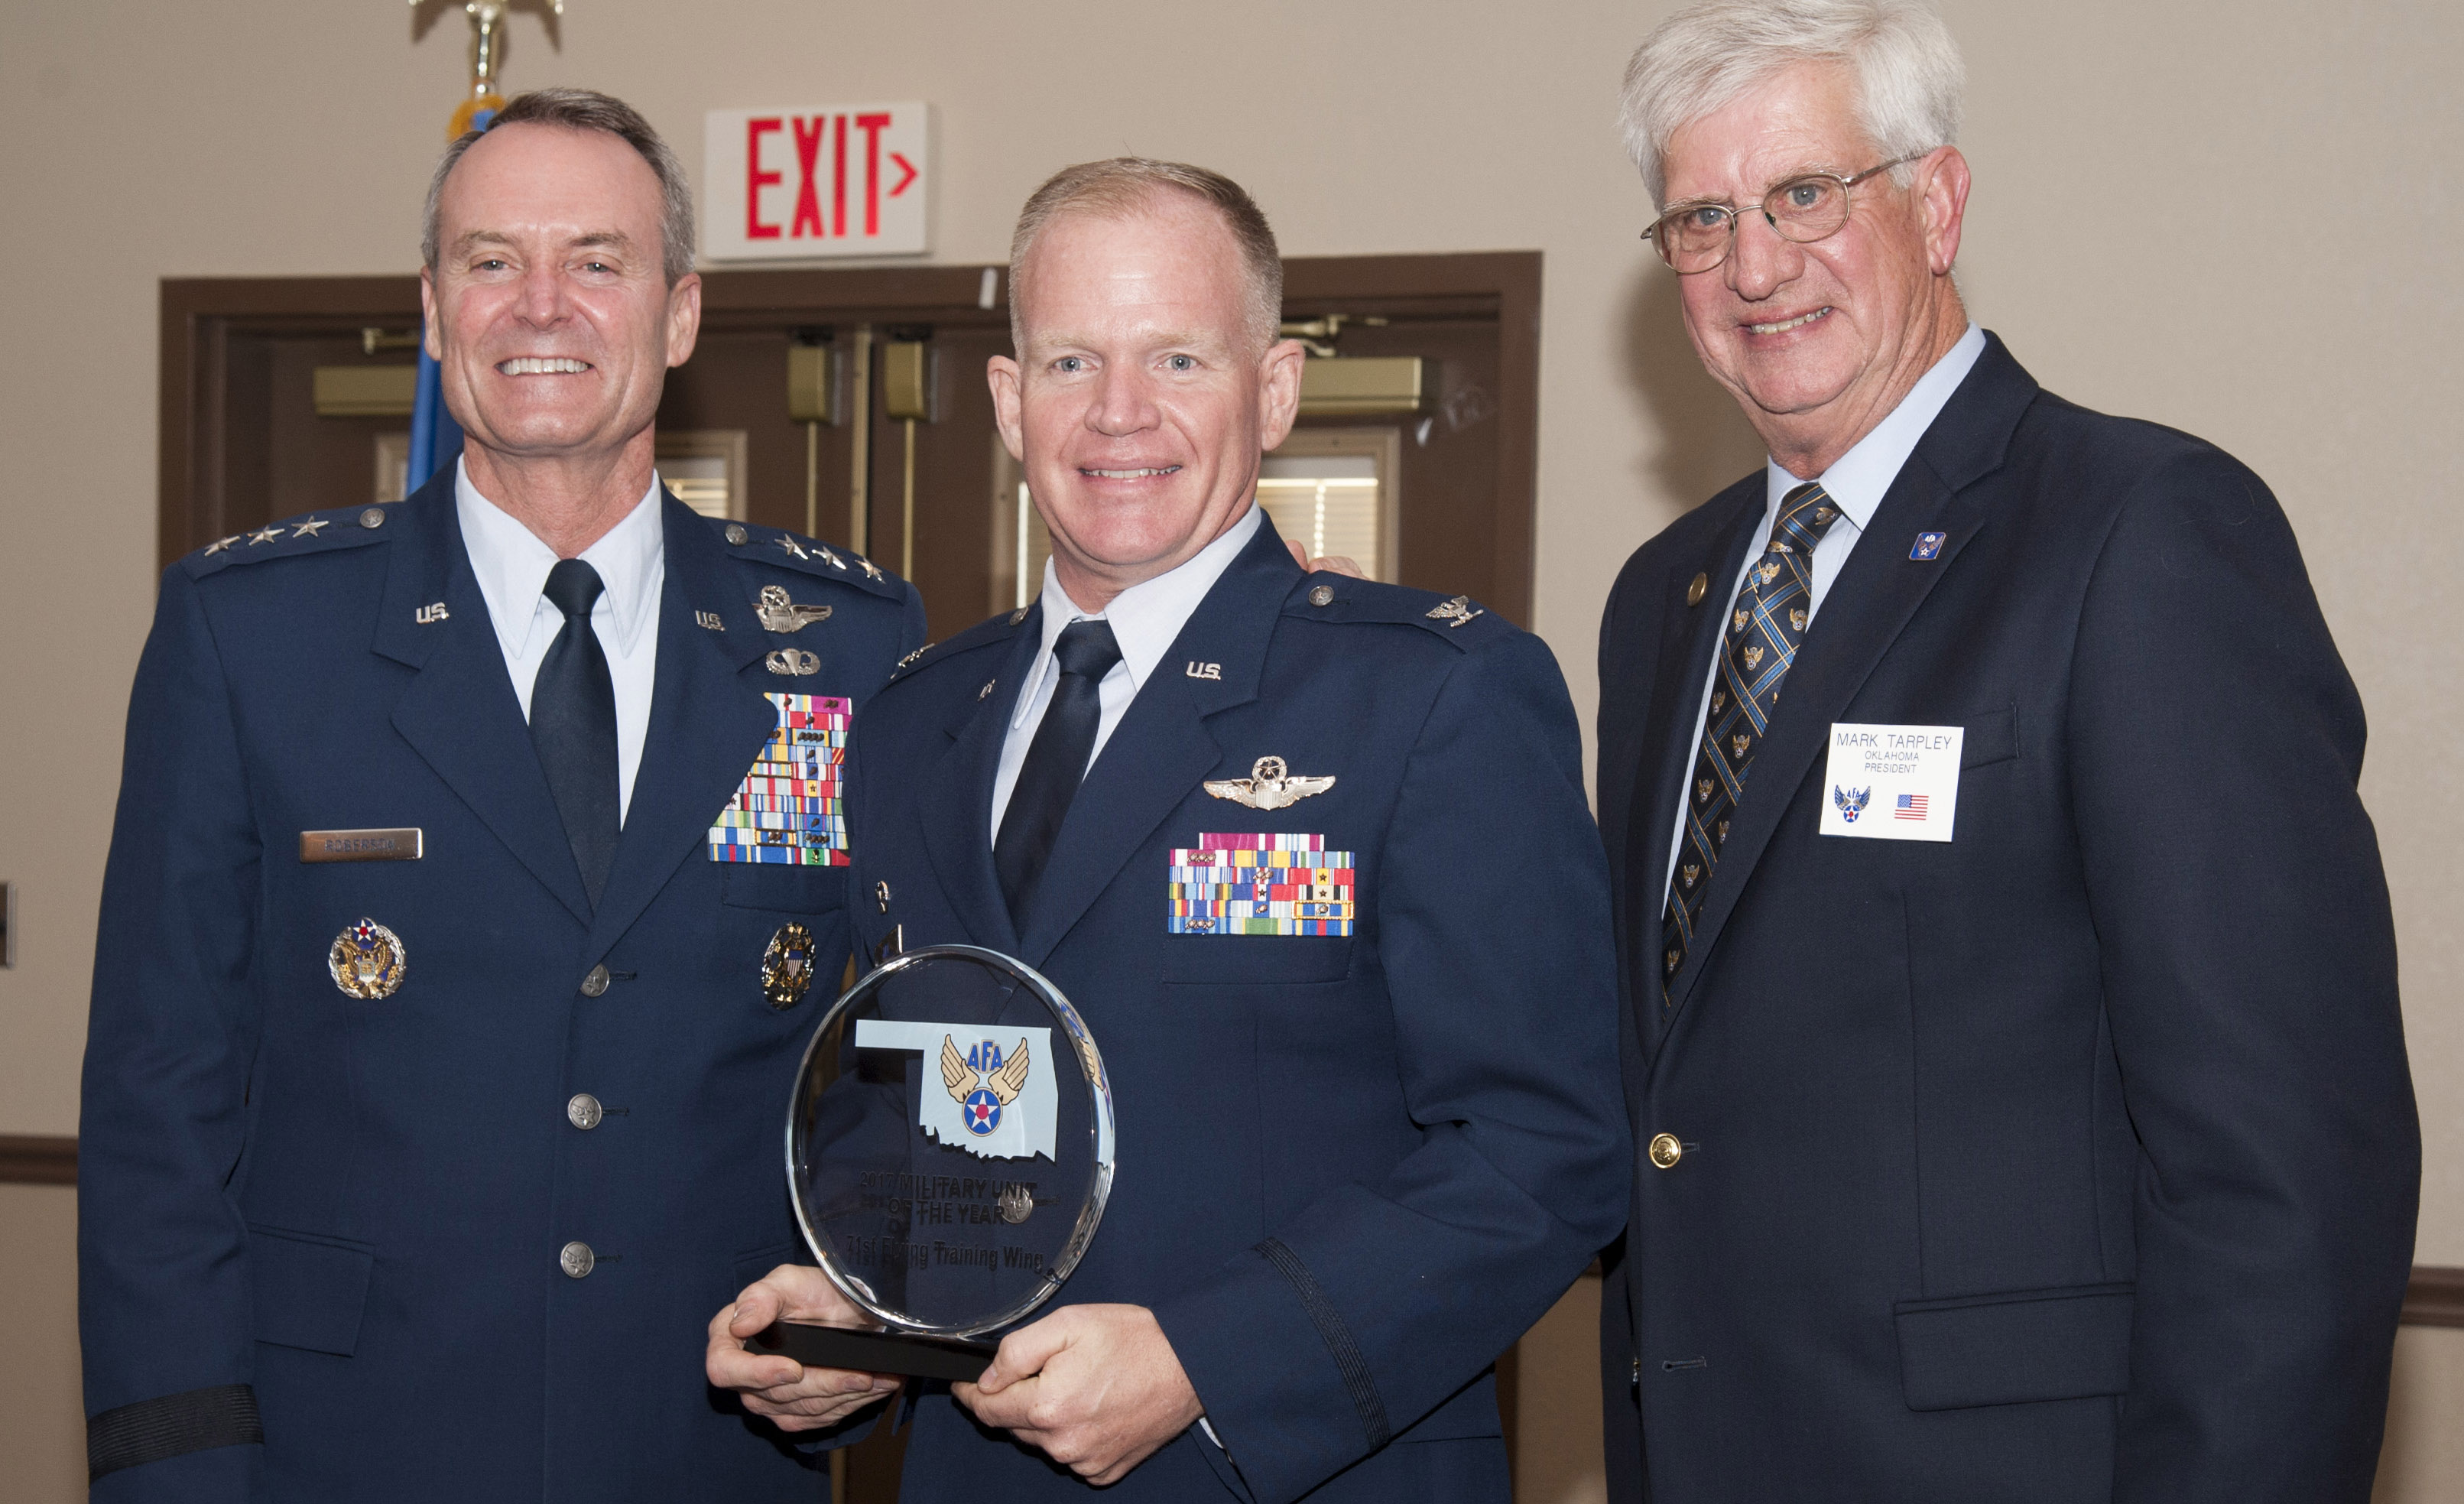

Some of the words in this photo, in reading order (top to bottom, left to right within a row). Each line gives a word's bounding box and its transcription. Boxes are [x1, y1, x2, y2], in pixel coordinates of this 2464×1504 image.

[746, 112, 891, 241] EXIT
[1836, 733, 1878, 748] MARK
[1888, 734, 1952, 750] TARPLEY
[1865, 751, 1919, 761] OKLAHOMA
[1865, 763, 1917, 774] PRESIDENT
[1846, 788, 1862, 799] AFA
[325, 839, 395, 853] ROBERSON
[967, 1039, 1004, 1074] AFA
[860, 1171, 894, 1187] 2017
[899, 1173, 987, 1198] MILITARY
[992, 1180, 1037, 1198] UNIT
[917, 1200, 953, 1223] THE
[958, 1204, 1005, 1224] YEAR
[934, 1240, 998, 1271] Training
[1003, 1246, 1043, 1273] Wing
